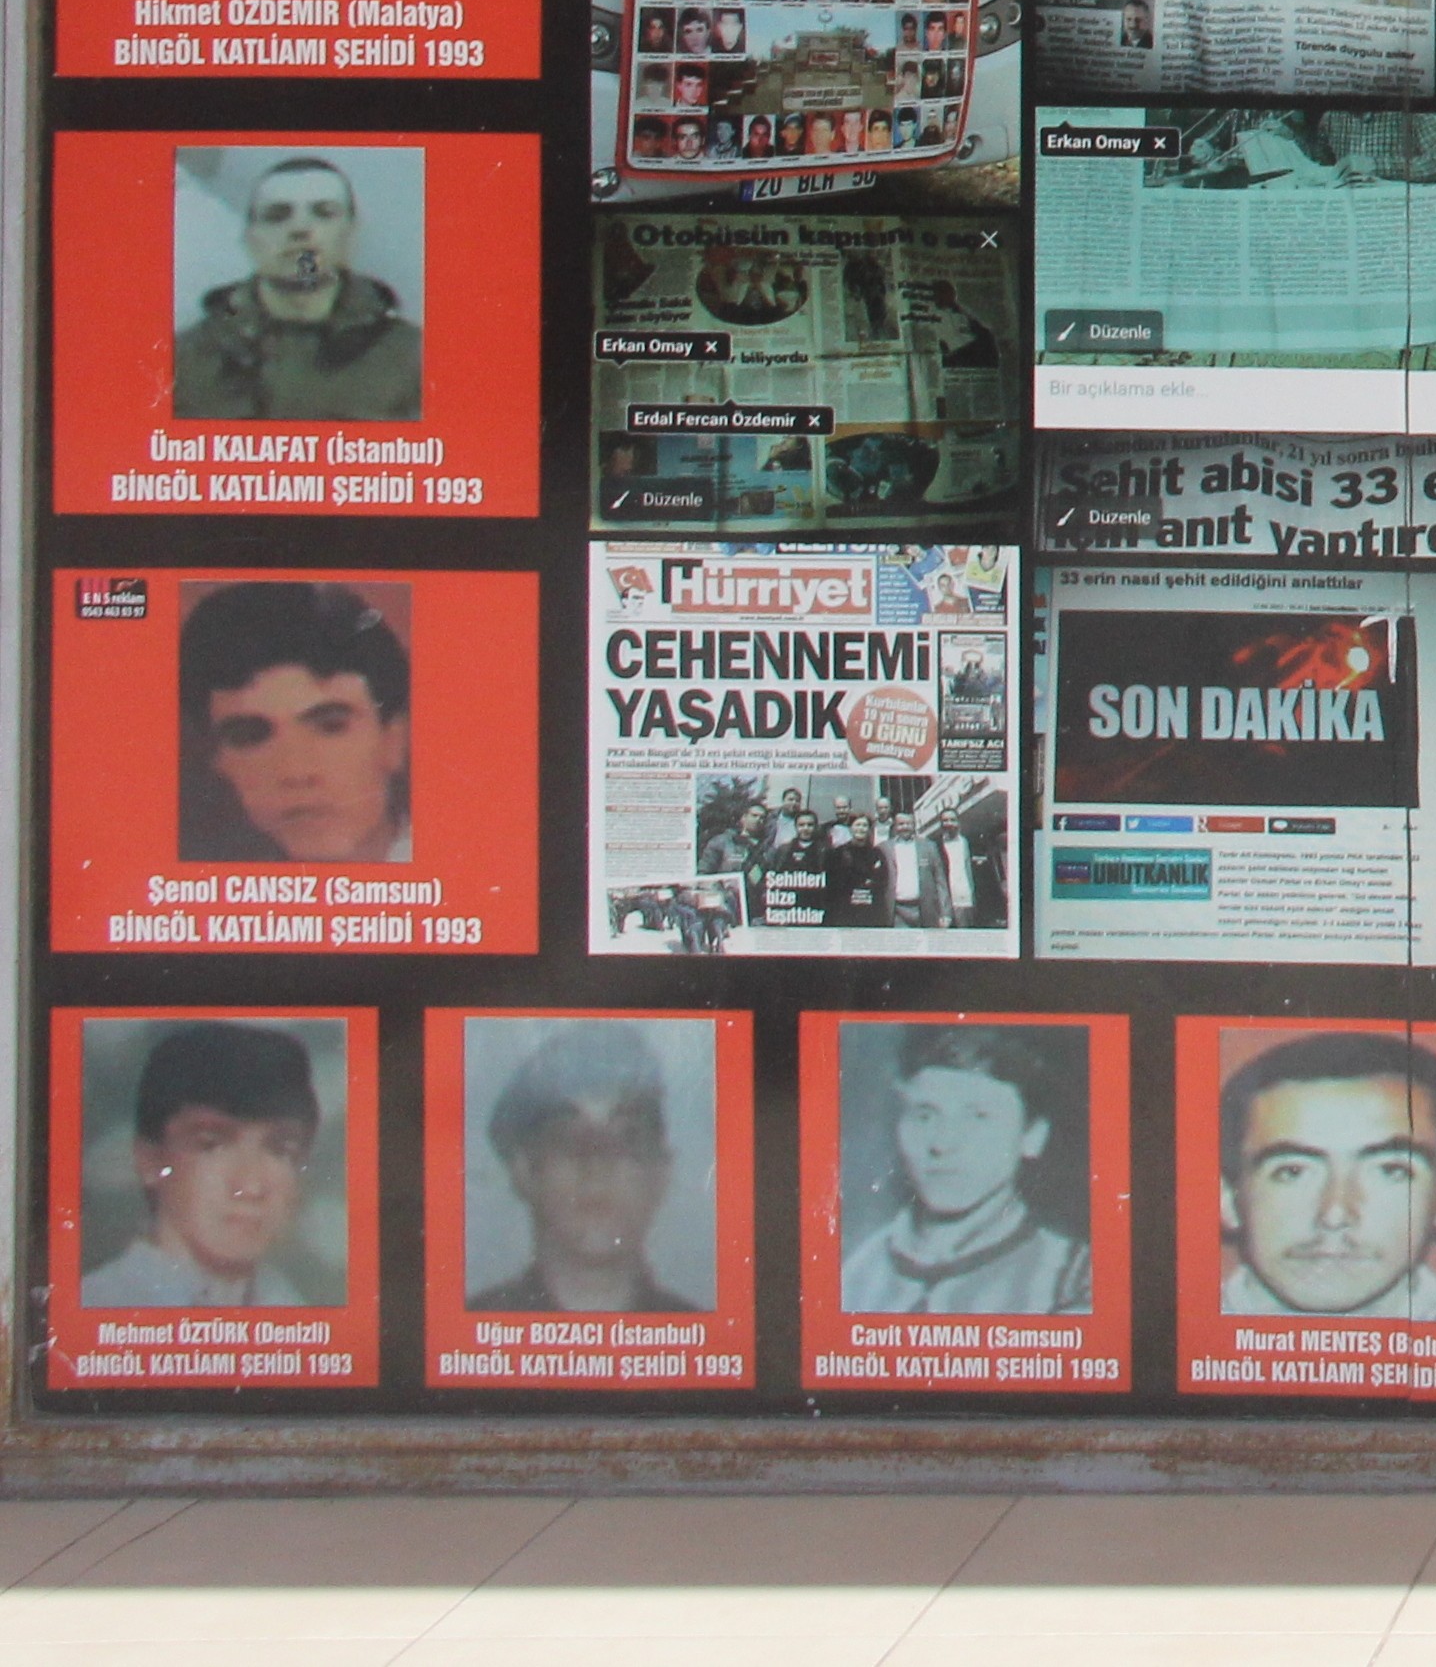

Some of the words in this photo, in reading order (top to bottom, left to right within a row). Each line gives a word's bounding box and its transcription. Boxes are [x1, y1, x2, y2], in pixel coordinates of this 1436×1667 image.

[347, 0, 464, 31] (Malatya)
[1046, 133, 1092, 149] Erkan
[1095, 134, 1142, 153] Omay
[1089, 323, 1152, 340] Düzenle
[149, 428, 207, 463] Ünal
[212, 434, 320, 463] KALAFAT
[325, 430, 445, 467] (İstanbul)
[669, 565, 869, 614] Hürriyet
[606, 687, 848, 746] YAŞADIK
[1088, 683, 1189, 739] SON
[1200, 678, 1386, 742] DAKİKA
[147, 875, 219, 907] Şenol
[224, 875, 318, 904] CANSIZ
[324, 876, 442, 907] (Samsun)
[475, 1322, 525, 1348] Uğur
[529, 1322, 604, 1346] BOZACI
[609, 1319, 706, 1348] (İstanbul)
[850, 1324, 903, 1347] Cavit
[907, 1325, 982, 1348] YAMAN
[986, 1325, 1083, 1350] (Samsun)
[1234, 1328, 1297, 1353] Murat
[1300, 1329, 1384, 1357] MENTEŞ
